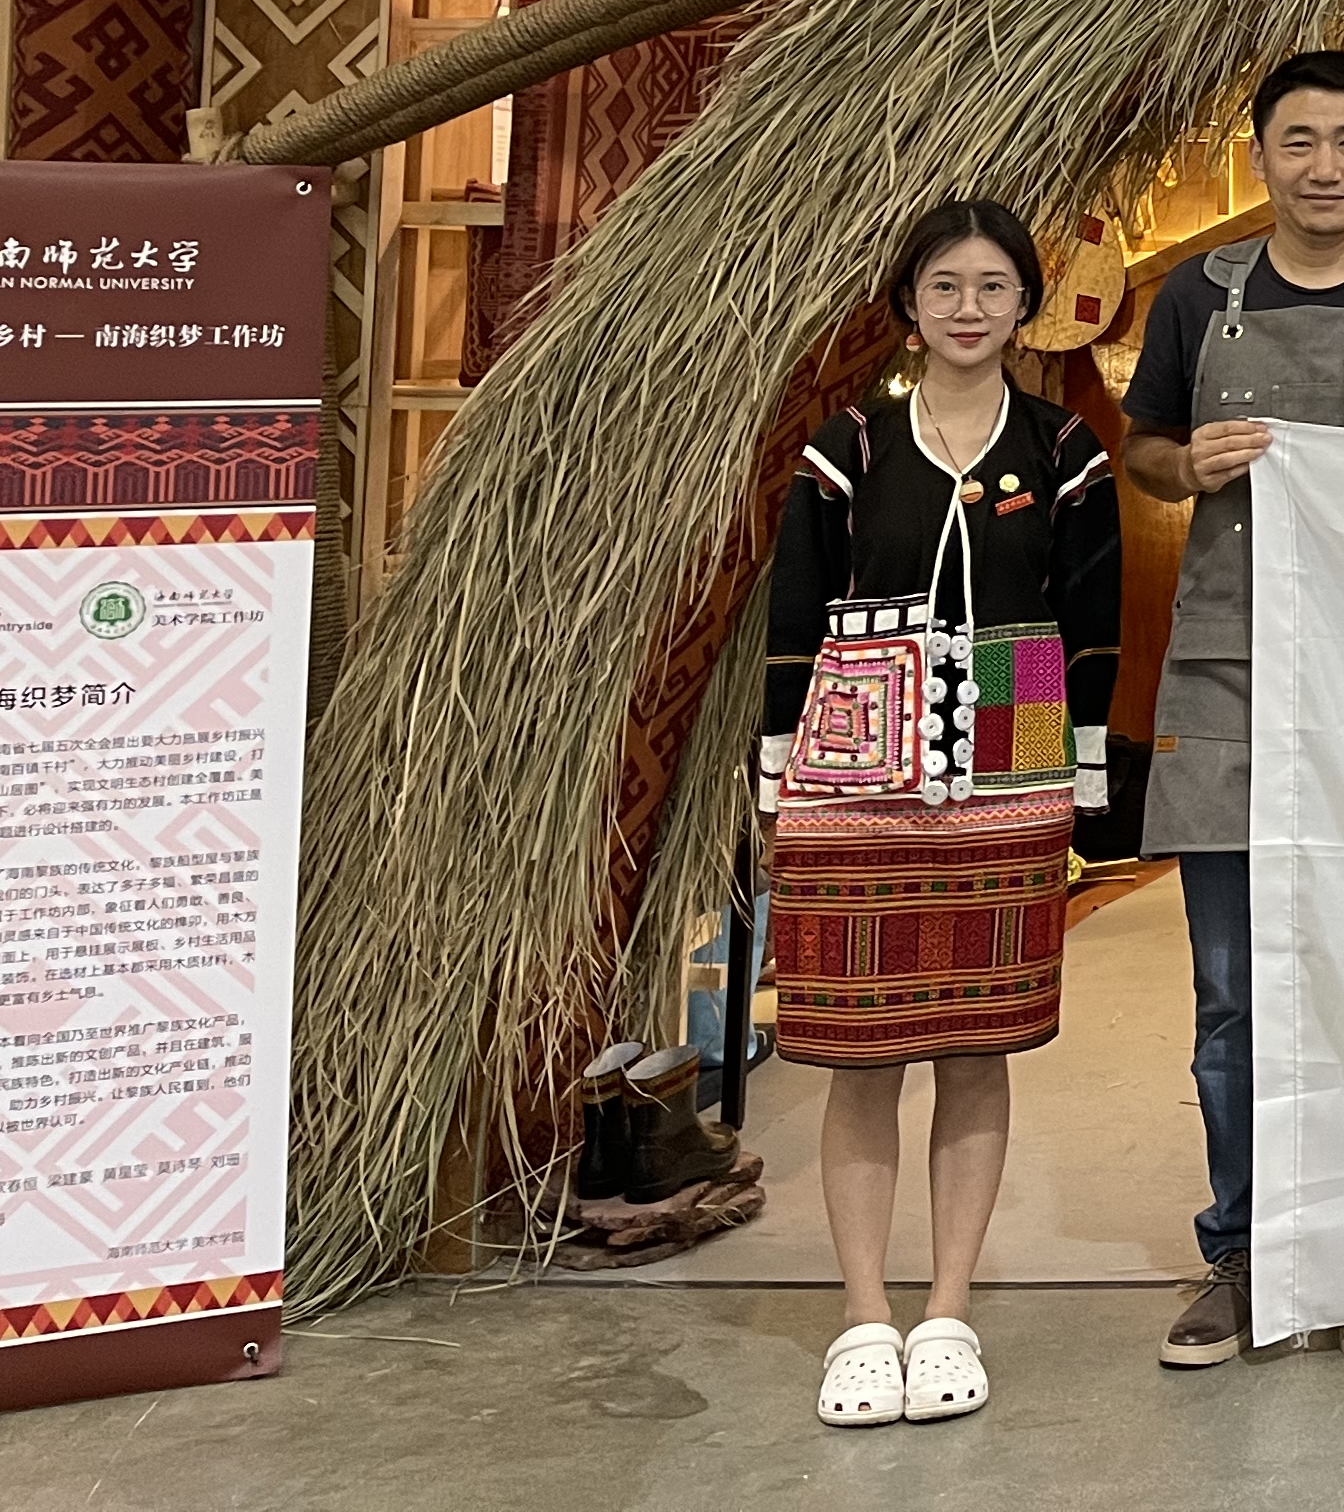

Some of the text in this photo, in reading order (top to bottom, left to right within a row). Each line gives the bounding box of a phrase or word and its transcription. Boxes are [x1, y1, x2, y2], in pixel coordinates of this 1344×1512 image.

[20, 276, 94, 290] NORMAL
[99, 276, 196, 291] UNIVERSITY
[95, 324, 286, 348] 南海织梦工作坊
[152, 610, 265, 628] 美术学院工作坊
